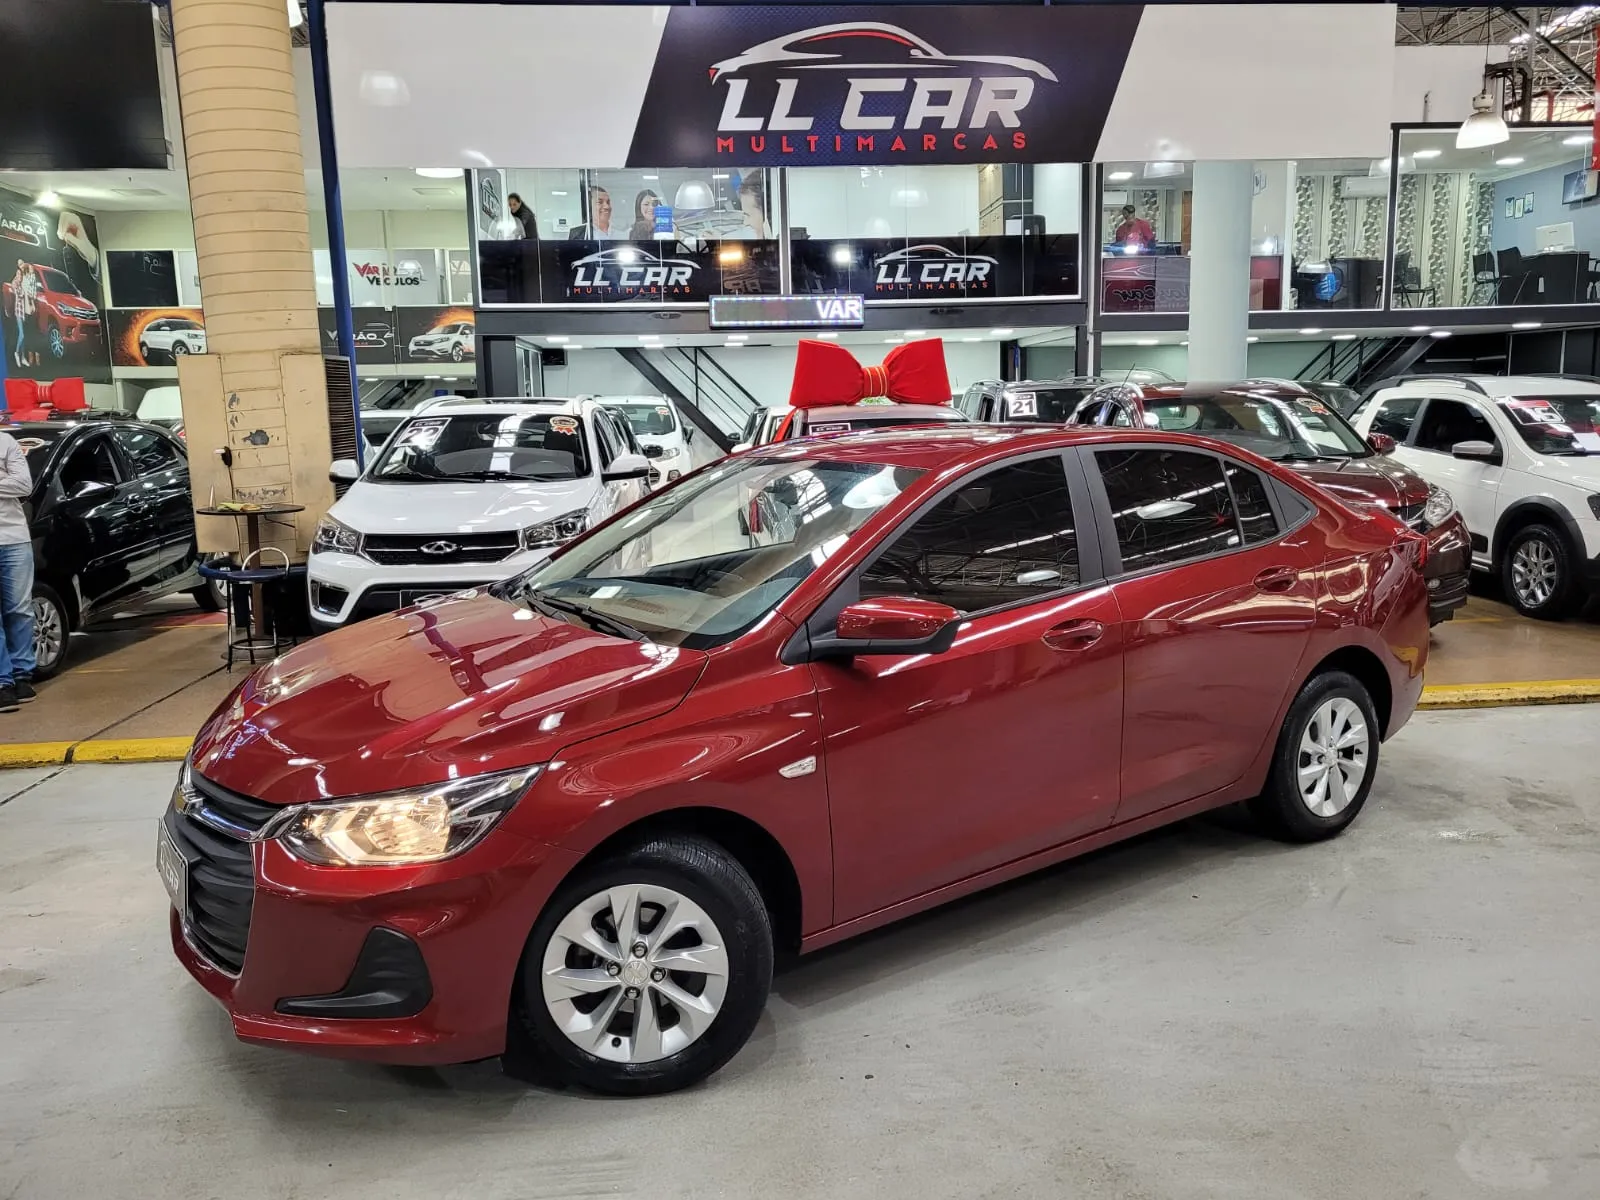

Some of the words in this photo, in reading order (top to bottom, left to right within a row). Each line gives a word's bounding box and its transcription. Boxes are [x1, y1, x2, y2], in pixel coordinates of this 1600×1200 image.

[717, 78, 815, 131] LL
[839, 76, 1035, 130] CAR
[716, 132, 1027, 153] MULTIMARCAS
[0, 212, 33, 236] ARÃO
[574, 267, 611, 287] LL
[619, 266, 693, 286] CAR
[876, 264, 912, 284] LL
[919, 262, 991, 283] CAR
[573, 286, 692, 295] MULTIMARCAS
[875, 281, 989, 292] MULTIMARCAS
[815, 299, 861, 319] VAR
[325, 329, 377, 341] VÃO
[1012, 400, 1034, 414] 21
[1520, 407, 1562, 422] 16
